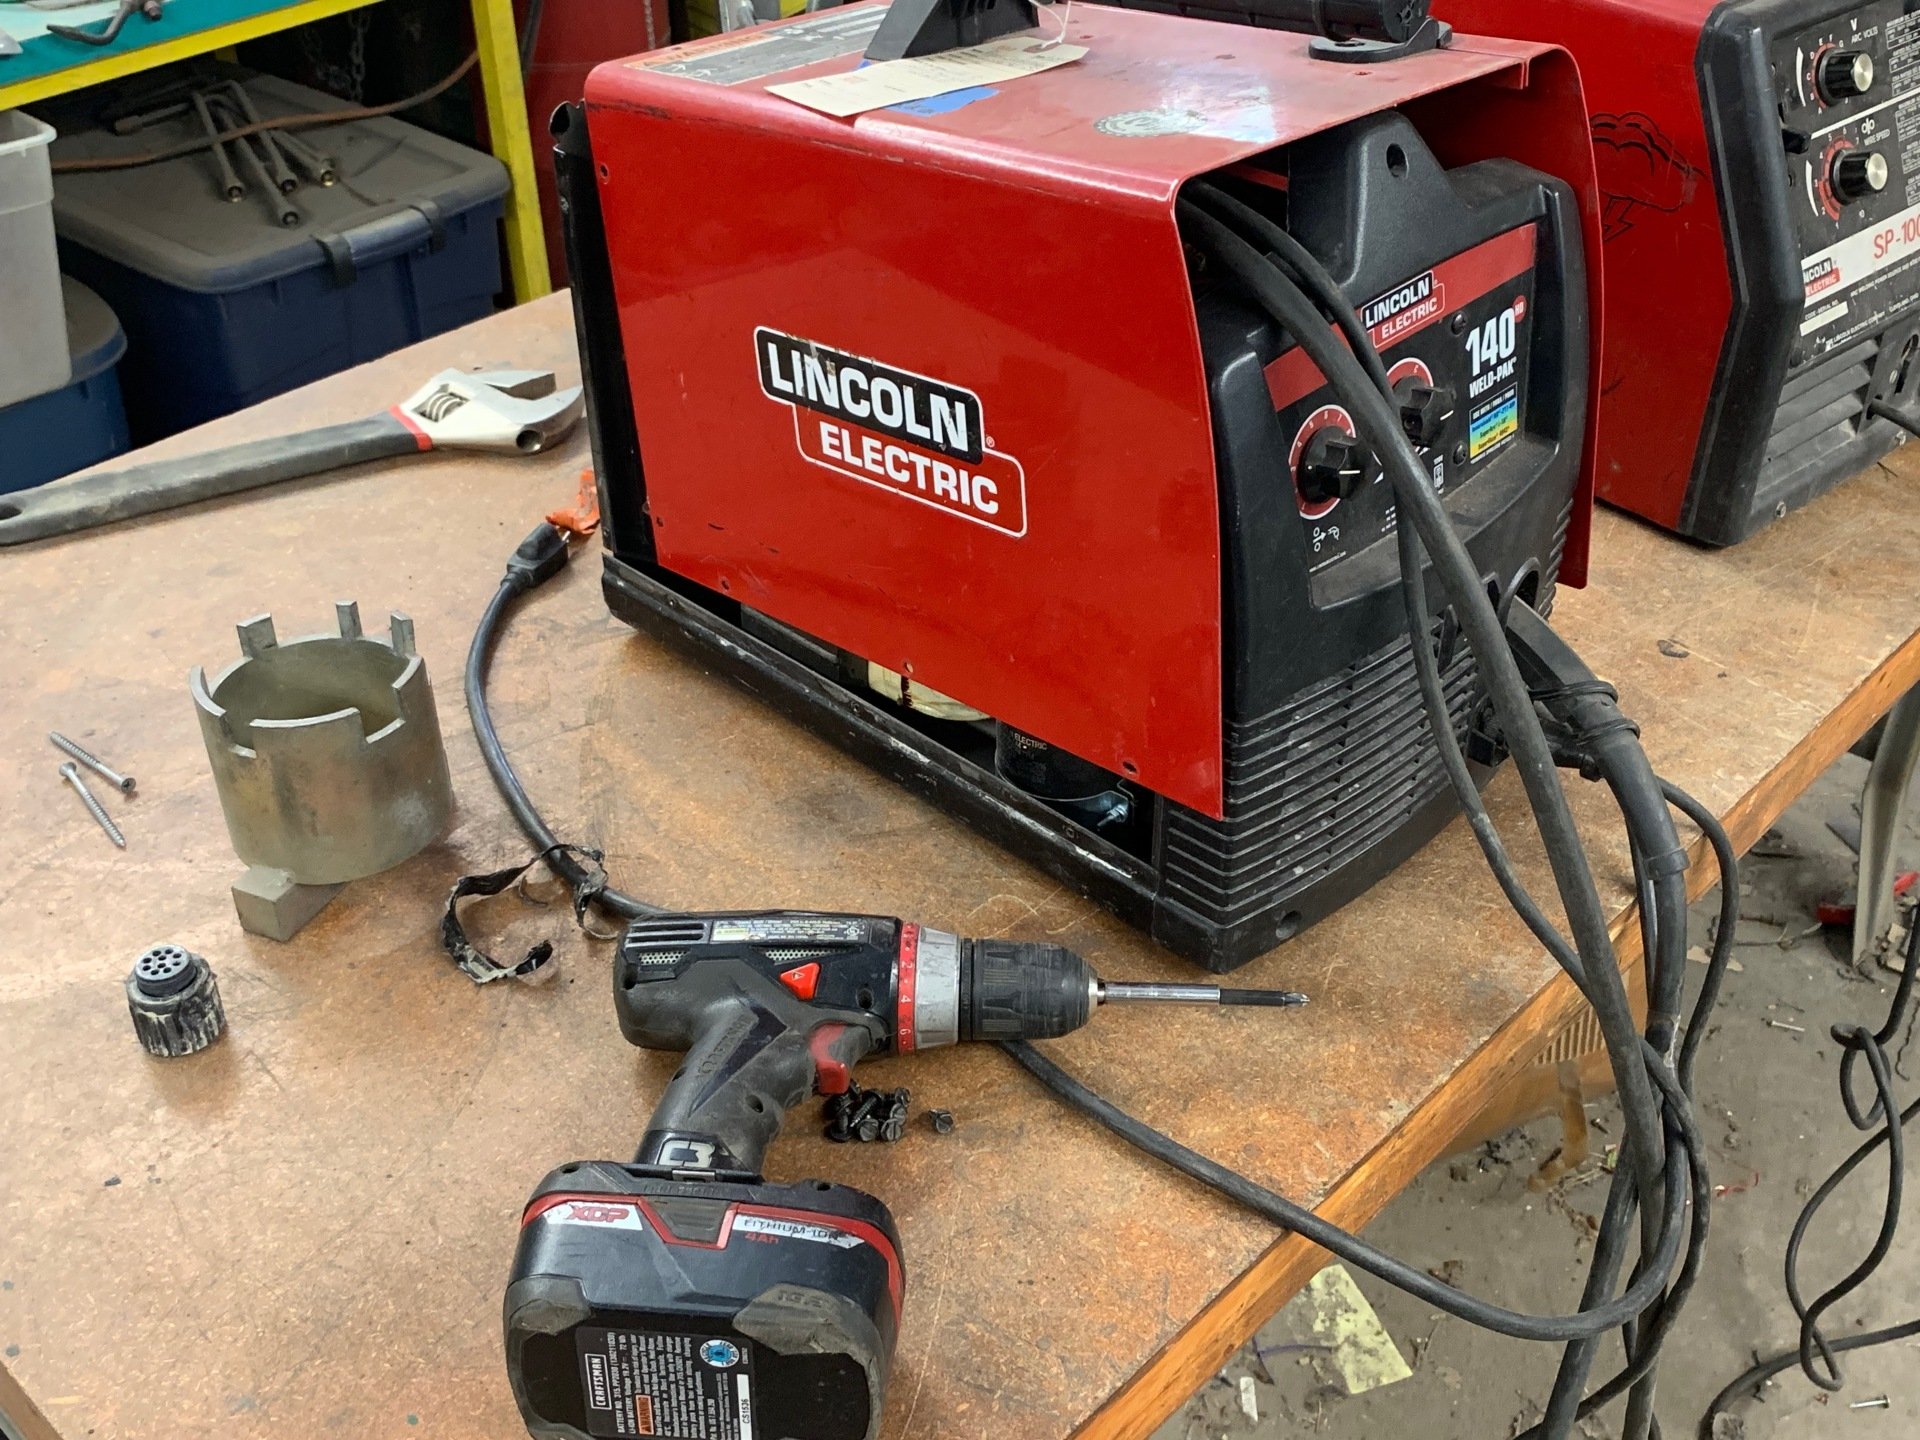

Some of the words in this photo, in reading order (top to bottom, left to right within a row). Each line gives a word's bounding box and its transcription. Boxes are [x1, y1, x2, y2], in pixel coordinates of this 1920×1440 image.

[1850, 18, 1858, 31] V
[1851, 32, 1863, 44] ARC
[1863, 26, 1878, 38] VOLTS
[1864, 136, 1877, 146] WIRE
[1876, 128, 1890, 142] SPEED
[1365, 276, 1430, 329] LINCOLN
[1381, 296, 1438, 339] ELECTRIC
[1464, 308, 1516, 376] 140
[1515, 302, 1524, 314] HD
[1469, 362, 1514, 398] WELD-PAK
[767, 342, 969, 452] LINCOLN
[820, 421, 999, 515] ELECTRIC
[1014, 732, 1048, 750] ELECTRIC
[900, 994, 912, 1003] 4
[564, 1206, 630, 1223] XCP
[745, 1232, 778, 1244] 4Ah
[592, 1357, 606, 1406] CRAFTSMAN
[624, 1378, 632, 1396] Voltage
[614, 1399, 622, 1409] NO.
[741, 1398, 750, 1424] CS1536
[616, 1410, 626, 1433] BATTERY
[626, 1419, 636, 1434] LI-ION
